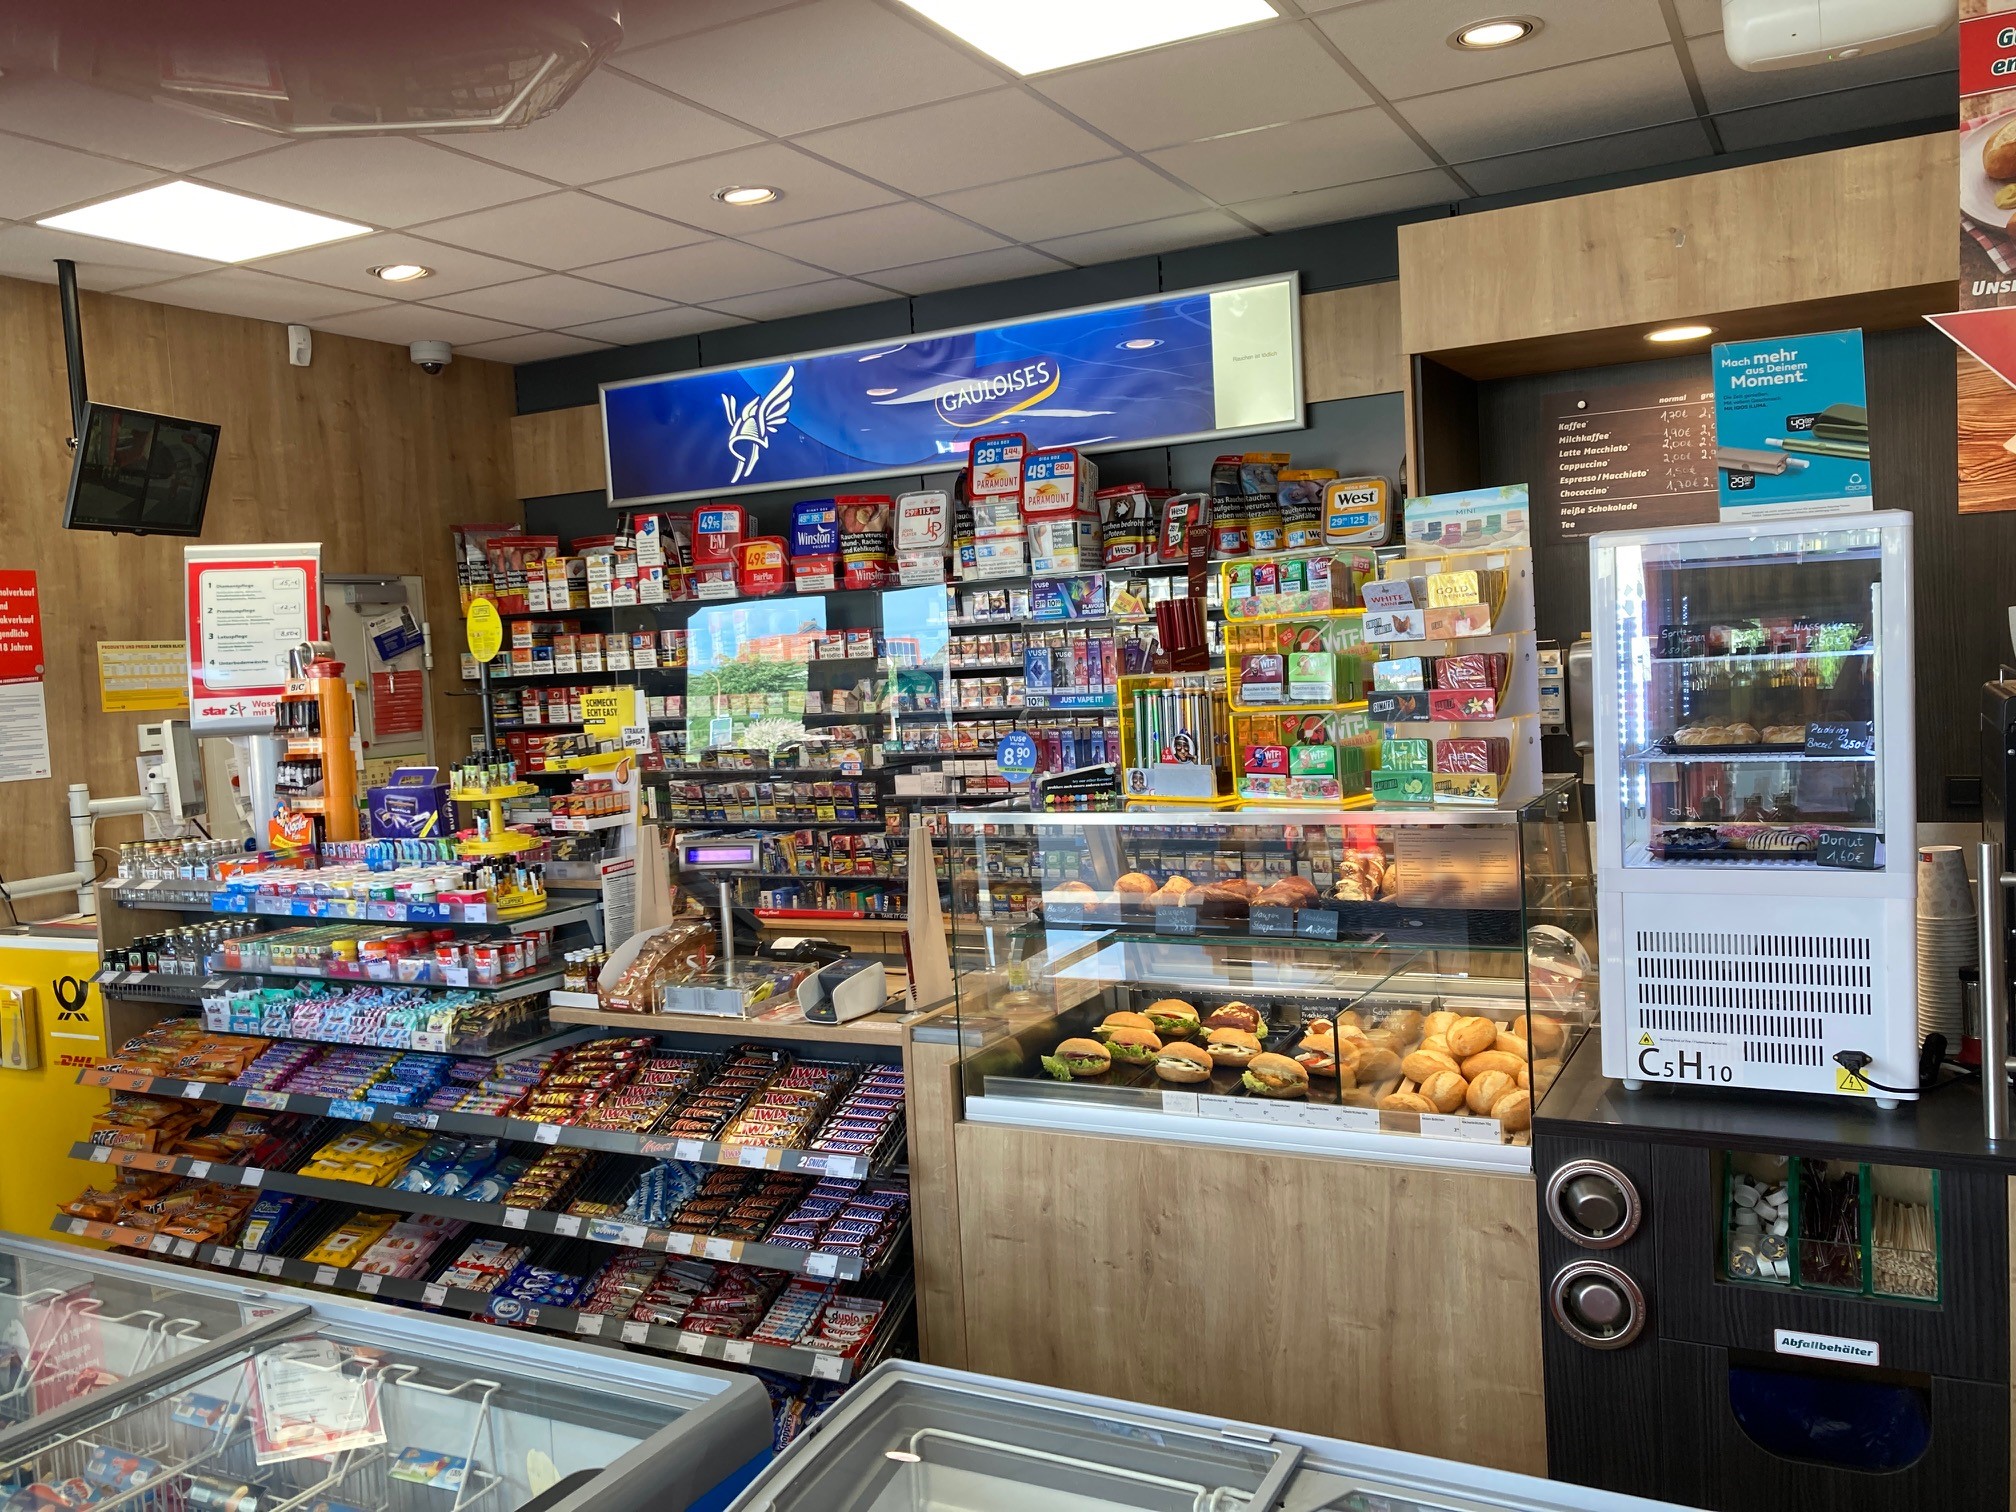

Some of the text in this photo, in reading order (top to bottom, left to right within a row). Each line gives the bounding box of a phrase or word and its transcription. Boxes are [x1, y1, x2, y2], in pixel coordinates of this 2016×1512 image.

[1721, 348, 1798, 368] Mach mehr
[1766, 362, 1808, 374] Deinem
[1731, 370, 1808, 389] Moment.
[942, 362, 1050, 411] GAULOISES
[1659, 391, 1715, 404] normal gro
[1558, 449, 1581, 458] Latte
[976, 476, 1018, 489] PARAMOUNT
[1028, 493, 1069, 506] PARAMOUNT
[1245, 494, 1271, 502] Rauchen
[1338, 492, 1375, 505] West
[1171, 506, 1187, 515] West
[1214, 504, 1241, 513] aufgeben
[1560, 502, 1638, 516] Heiße Schokolade
[1561, 520, 1576, 529] Tee
[797, 531, 831, 546] Winston
[840, 533, 864, 541] Rauchen
[1114, 545, 1134, 554] West
[1436, 585, 1469, 595] GOLD
[1371, 594, 1404, 603] WHITE
[10, 642, 33, 652] Jahren
[586, 698, 617, 708] SCHMECKT
[202, 705, 227, 716] star
[587, 707, 618, 717] ECHT EASY
[1811, 723, 1850, 740] Pudding
[1821, 833, 1864, 847] Donut
[1826, 851, 1865, 864] 1,60€
[60, 1055, 95, 1067] DHL
[650, 1058, 684, 1070] TWIX
[789, 1066, 829, 1080] TWIX
[375, 1084, 402, 1092] mentos
[752, 1107, 790, 1121] TWIX
[835, 1220, 879, 1234] SNICKERS
[823, 1232, 865, 1243] SNICKERS
[832, 1310, 860, 1323] duplo
[1781, 1336, 1874, 1358] Abfallbehälter
